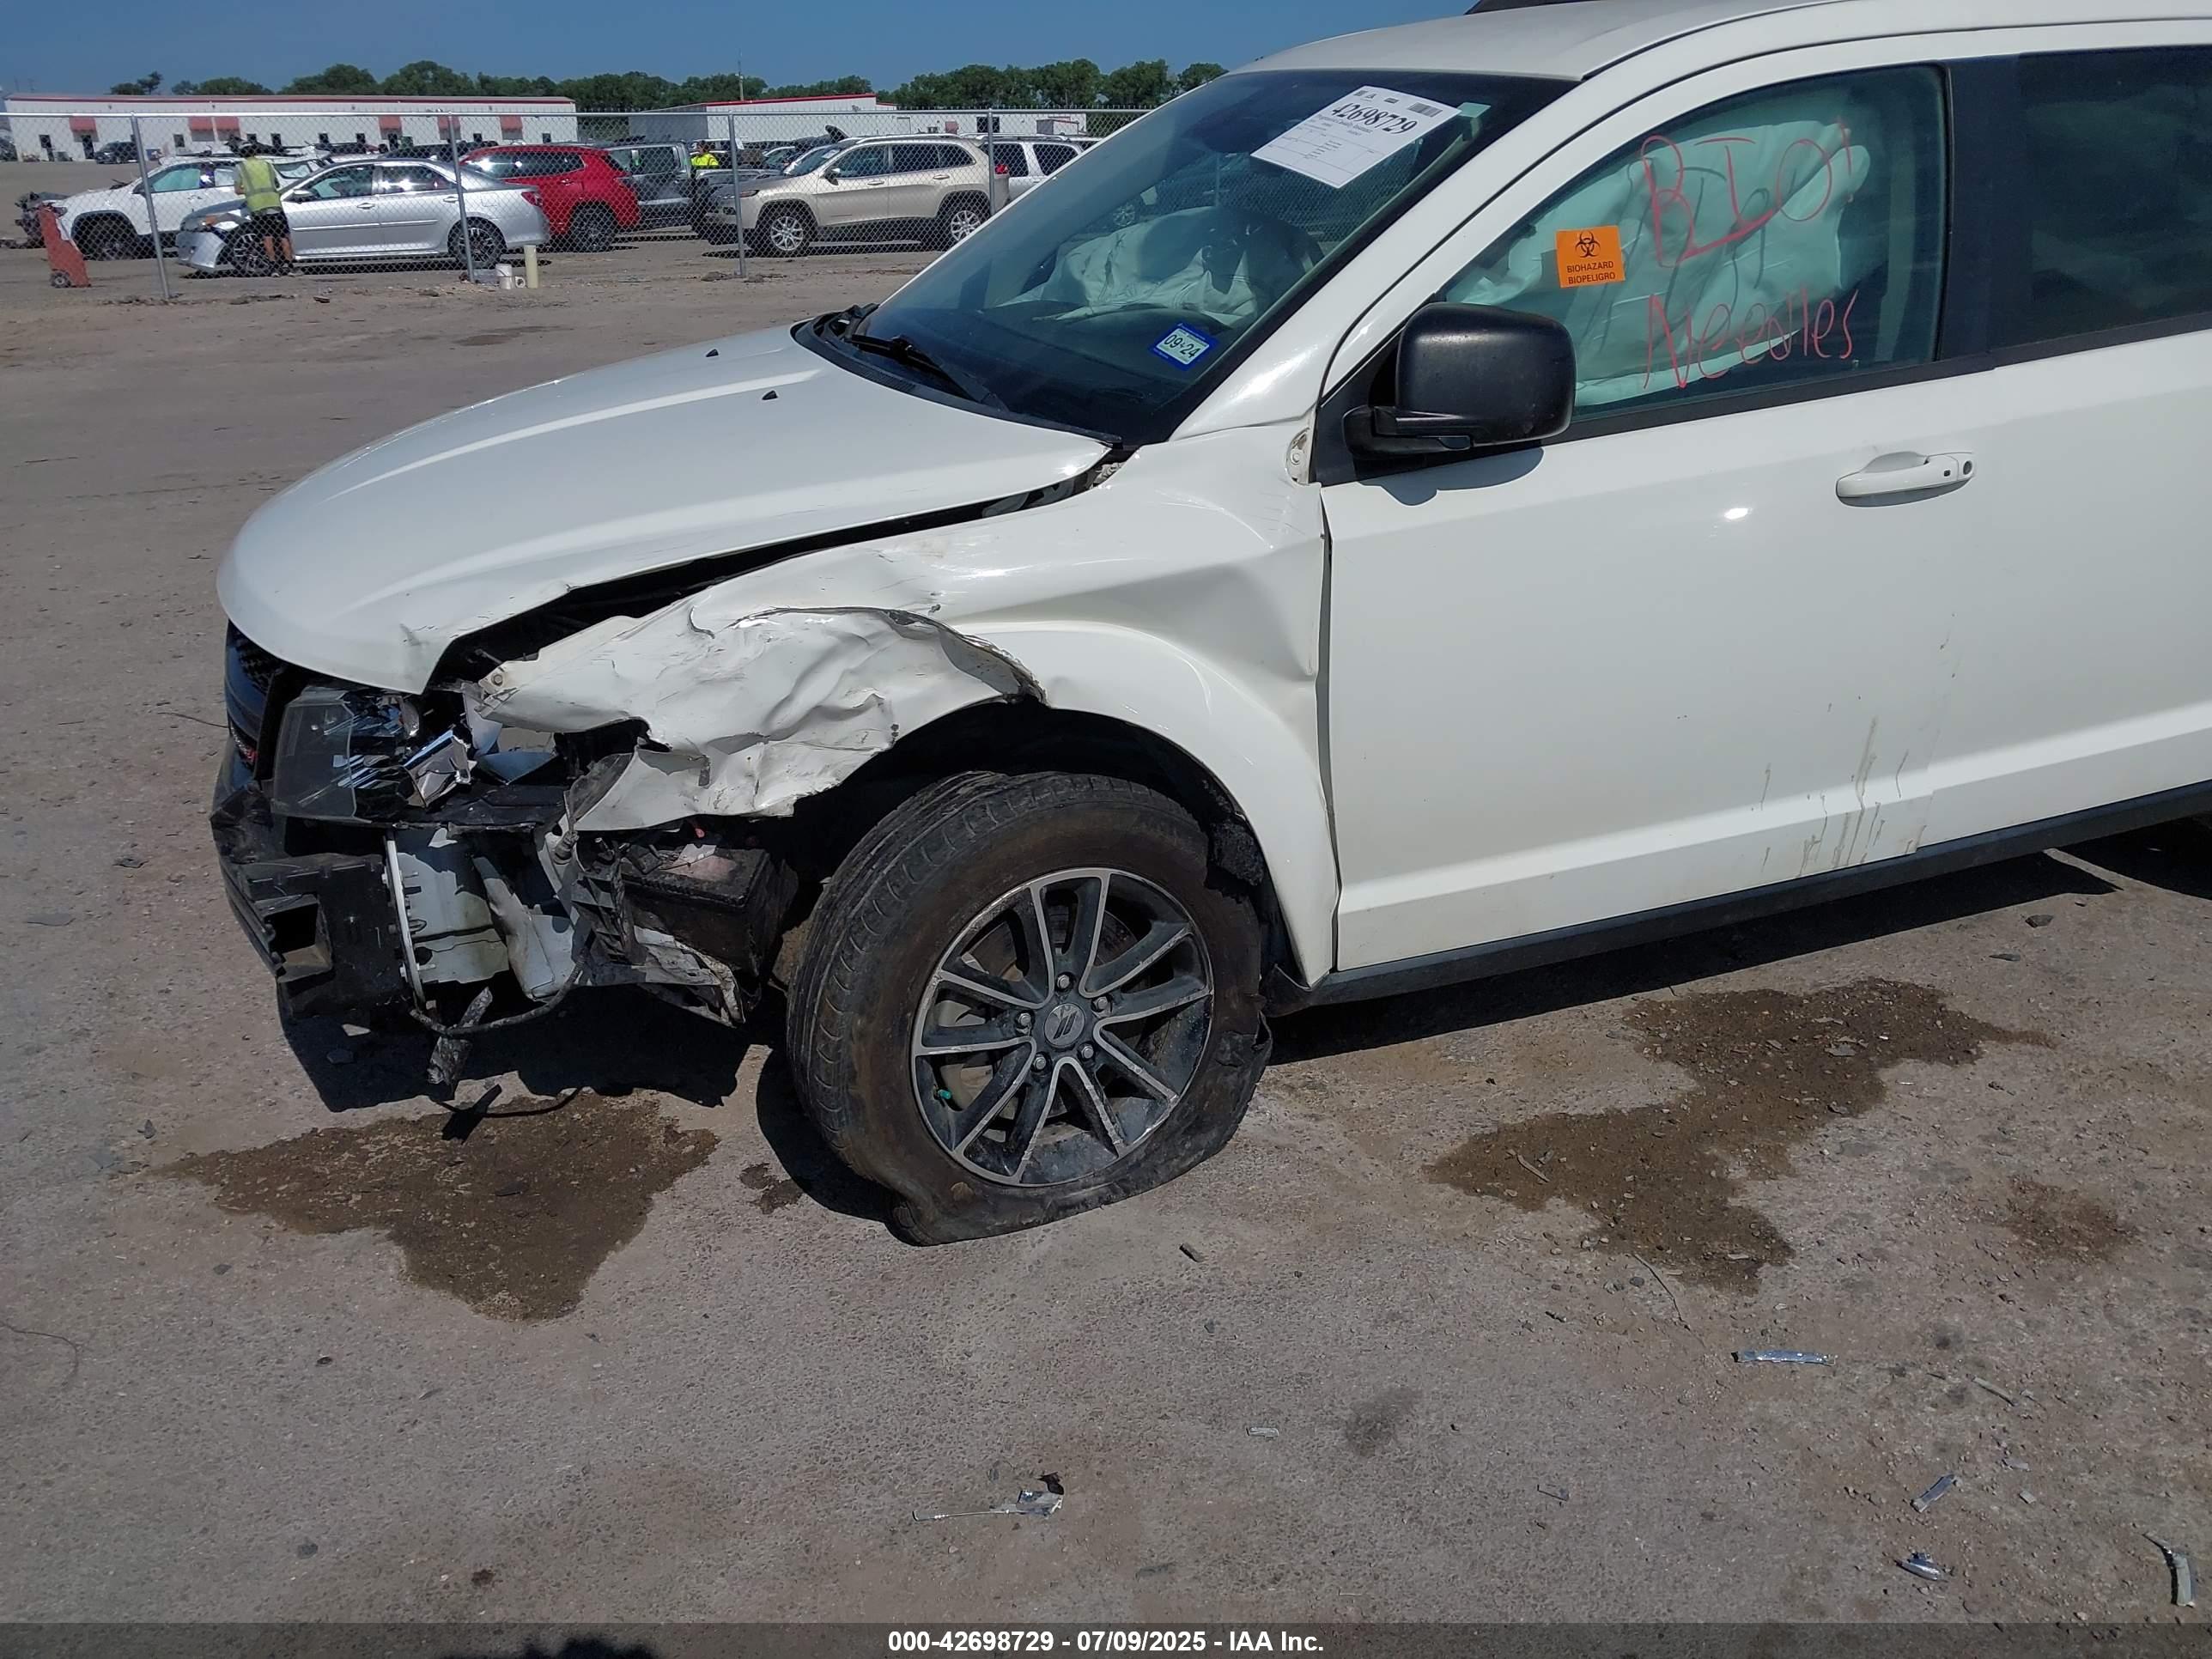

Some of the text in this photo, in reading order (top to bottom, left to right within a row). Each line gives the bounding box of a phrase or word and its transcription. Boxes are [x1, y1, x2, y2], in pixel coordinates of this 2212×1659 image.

[1331, 102, 1419, 135] 42698729
[1566, 260, 1614, 274] BIOHAZARD
[1568, 271, 1616, 285] BIOPELIGRO
[1643, 288, 1859, 390] Needles
